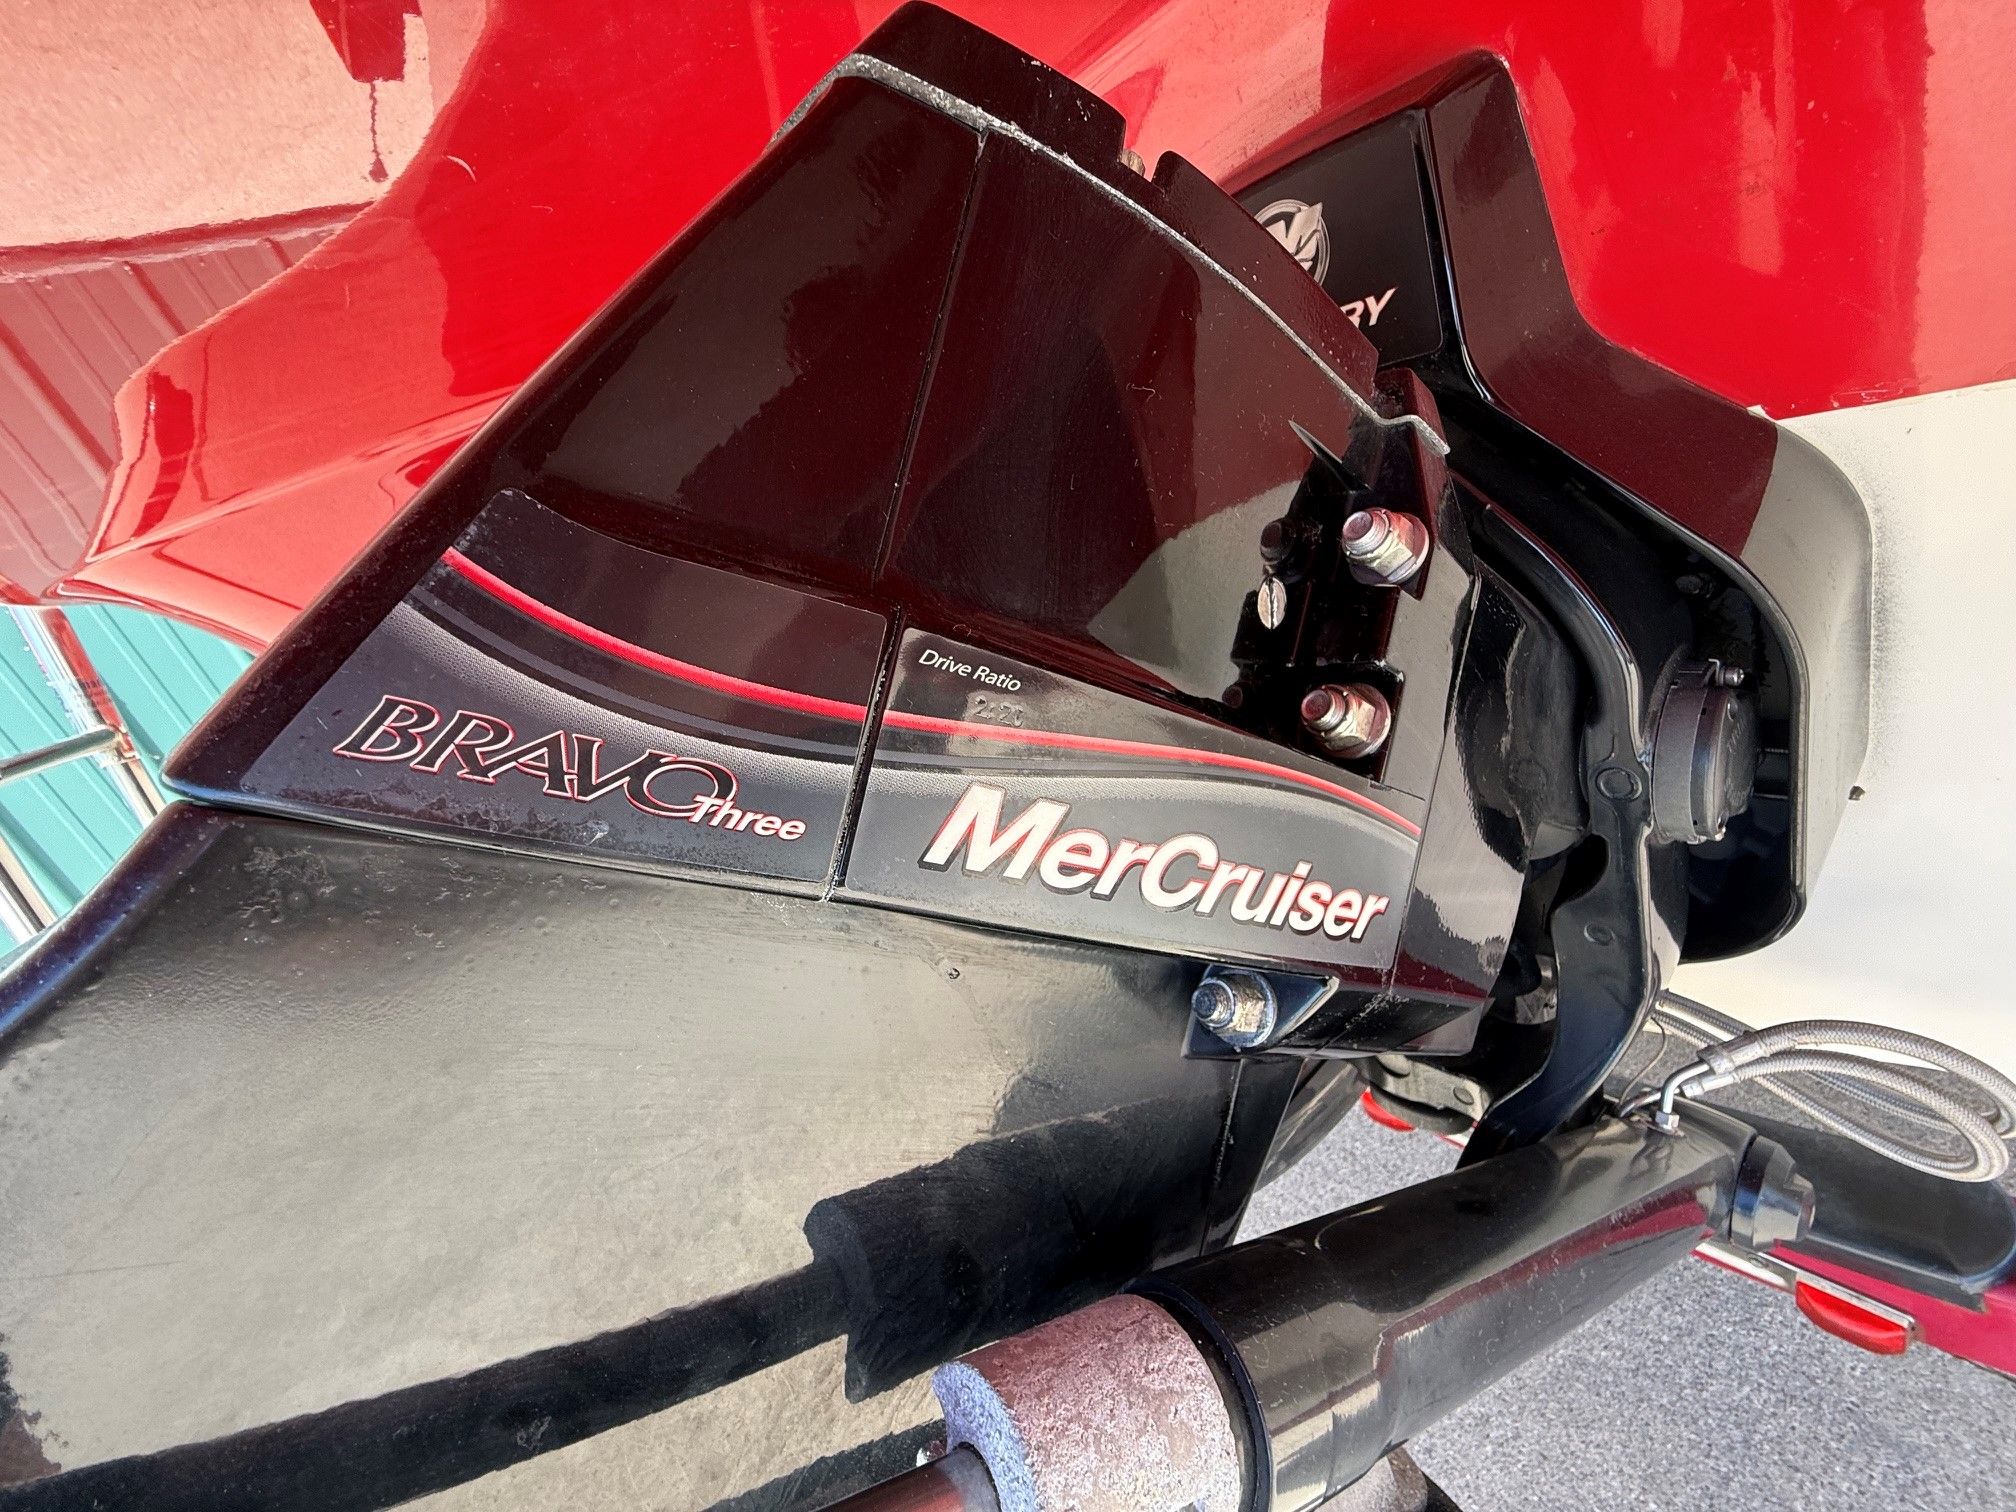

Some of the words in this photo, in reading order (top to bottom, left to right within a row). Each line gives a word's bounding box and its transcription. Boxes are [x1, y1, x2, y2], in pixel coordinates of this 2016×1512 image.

[918, 649, 972, 677] Drive
[973, 665, 1021, 691] Ratio
[333, 694, 738, 817] BRAVO
[692, 794, 806, 841] Three
[918, 780, 1390, 943] MerCruiser
